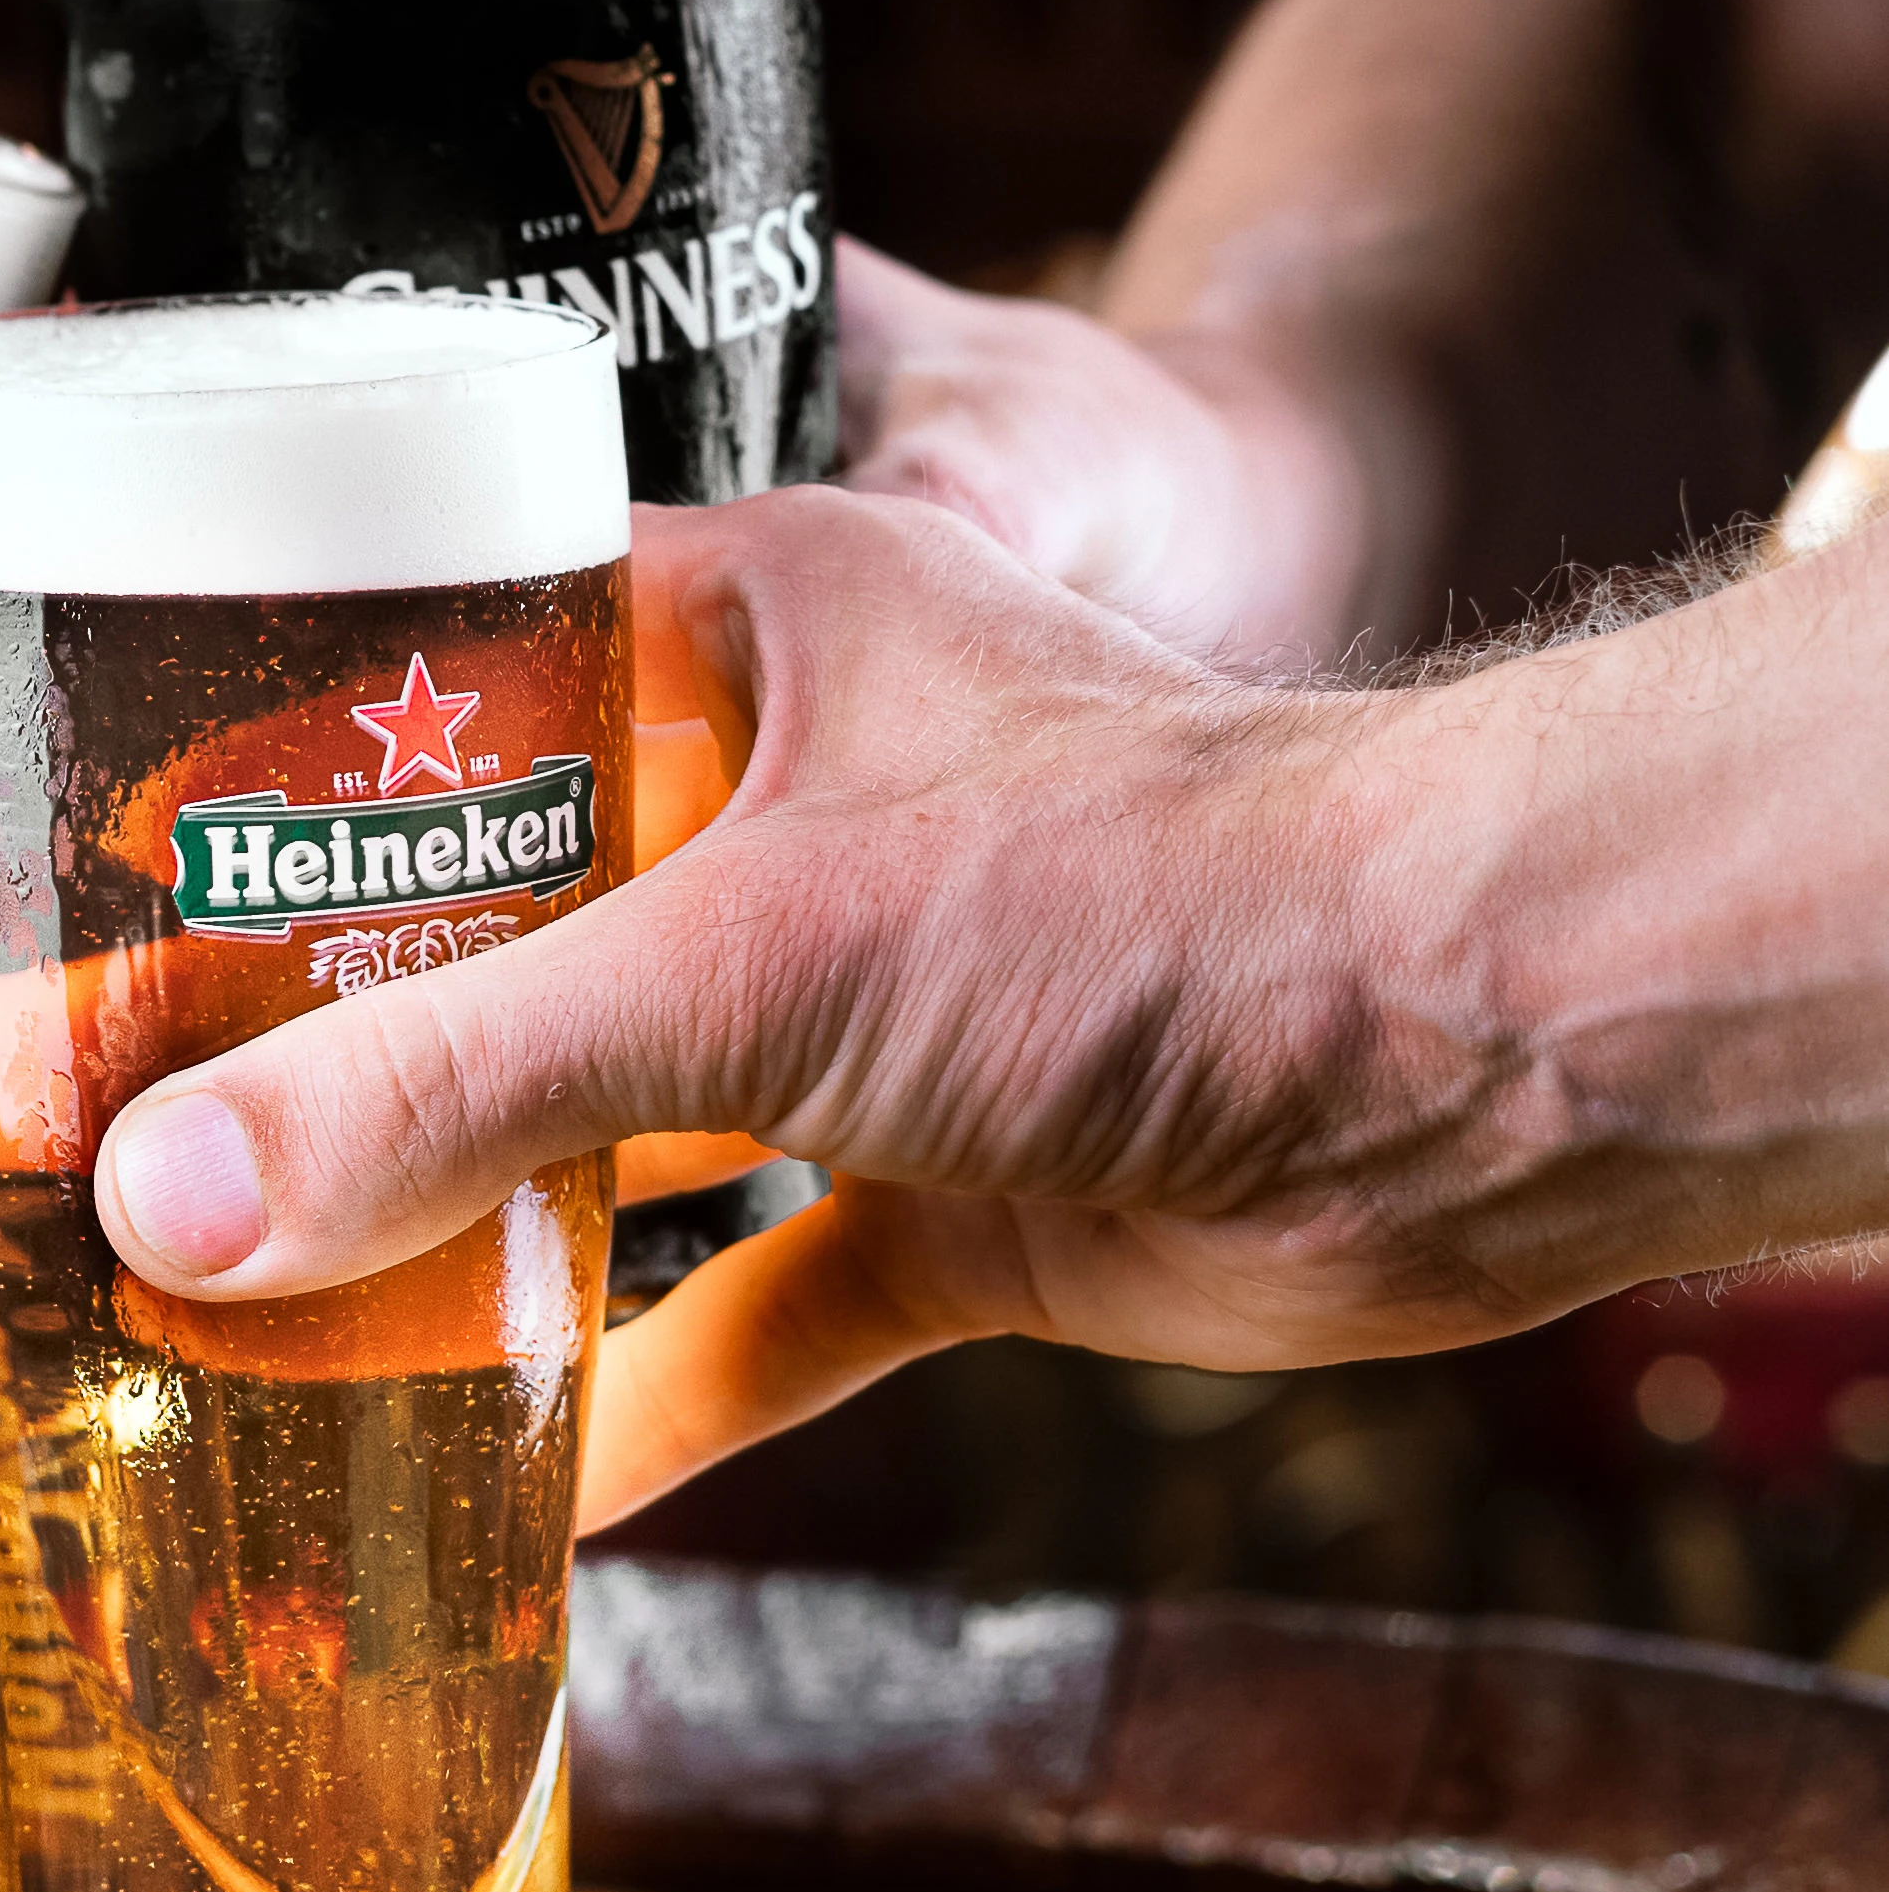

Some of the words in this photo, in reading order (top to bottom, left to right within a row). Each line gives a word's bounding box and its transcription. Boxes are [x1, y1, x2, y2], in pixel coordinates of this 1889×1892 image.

[341, 192, 820, 369] NNESS
[333, 771, 369, 790] EST.
[469, 753, 500, 774] 1873
[205, 801, 580, 901] Heineken
